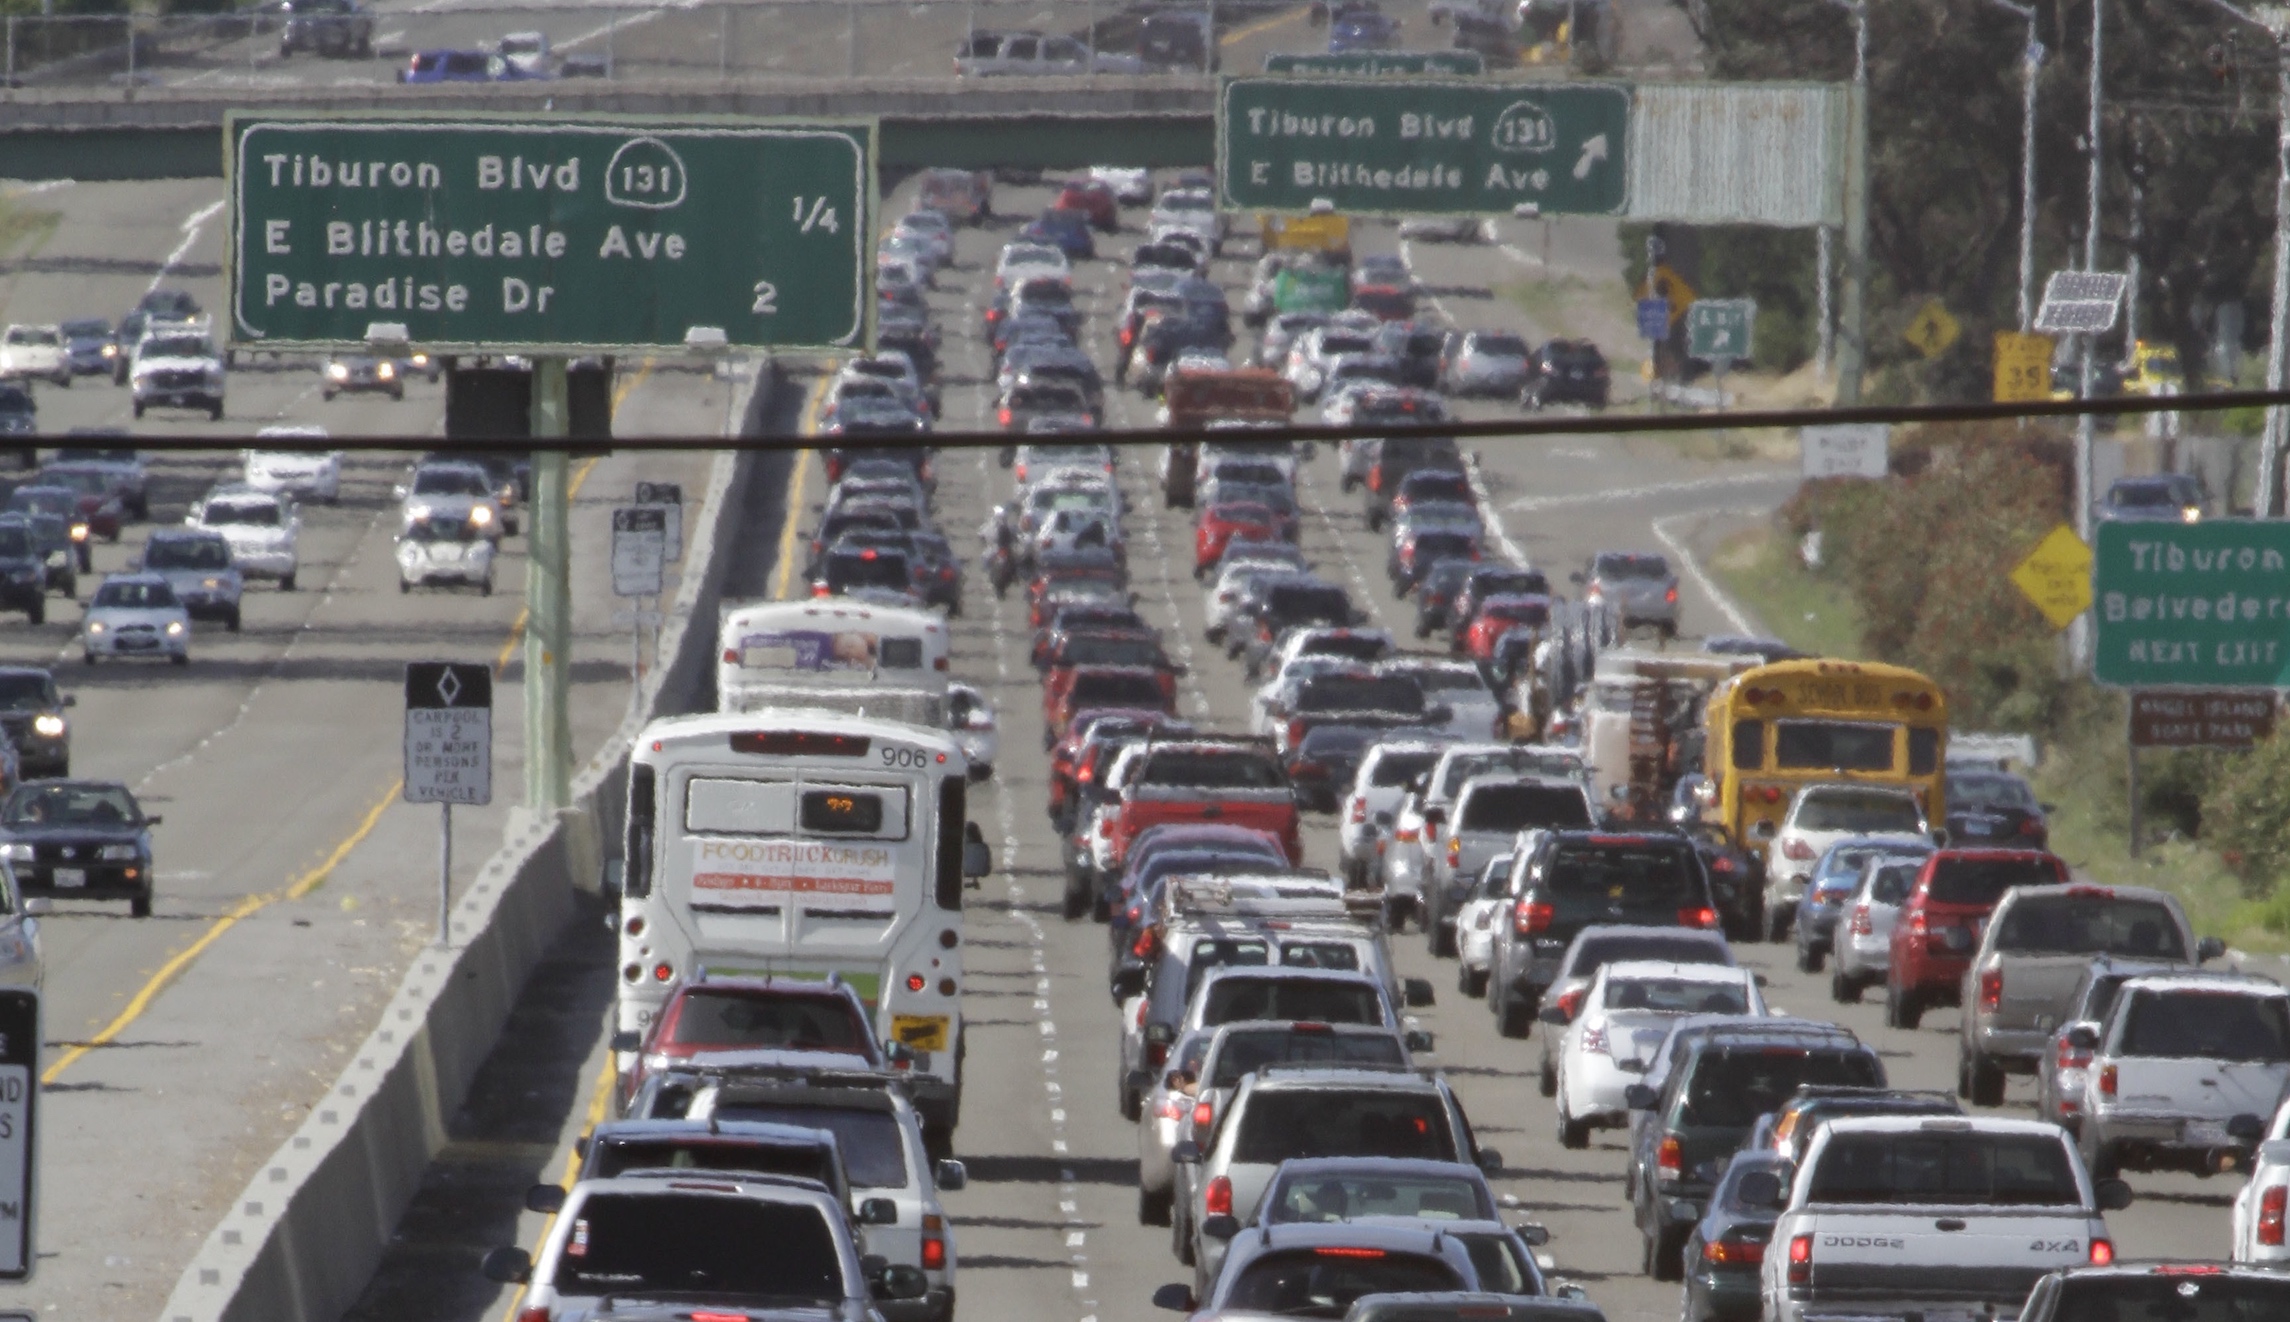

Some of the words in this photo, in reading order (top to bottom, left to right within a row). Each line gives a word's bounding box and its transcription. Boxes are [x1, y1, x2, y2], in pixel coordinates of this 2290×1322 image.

[1247, 106, 1376, 139] Tiburon
[1399, 111, 1474, 140] Blvd
[1504, 117, 1549, 145] 131
[263, 153, 440, 188] Tiburon
[478, 155, 580, 191] Blvd
[623, 165, 671, 193] 131
[1250, 159, 1271, 185] E
[1292, 160, 1462, 190] Blithedale
[1484, 162, 1550, 191] Ave
[793, 196, 839, 234] 1/4
[265, 220, 291, 254] E
[327, 219, 566, 258] Blithedale
[599, 225, 686, 259] Ave
[266, 273, 468, 311] Paradise
[503, 276, 554, 313] Dr
[752, 281, 778, 313] 2
[2127, 540, 2285, 572] Tiburon
[2104, 591, 2290, 622] Belveder
[2128, 639, 2199, 663] NEXT
[2215, 641, 2277, 666] EXIT
[414, 710, 480, 725] CARPOOL
[430, 726, 442, 739] IS
[451, 723, 462, 740] 2
[415, 741, 433, 753] OR
[442, 741, 478, 754] MORE
[415, 755, 479, 769] PERSONS
[881, 747, 927, 768] 906
[418, 786, 477, 801] VEHICLE
[1823, 1236, 1905, 1250] DODGE
